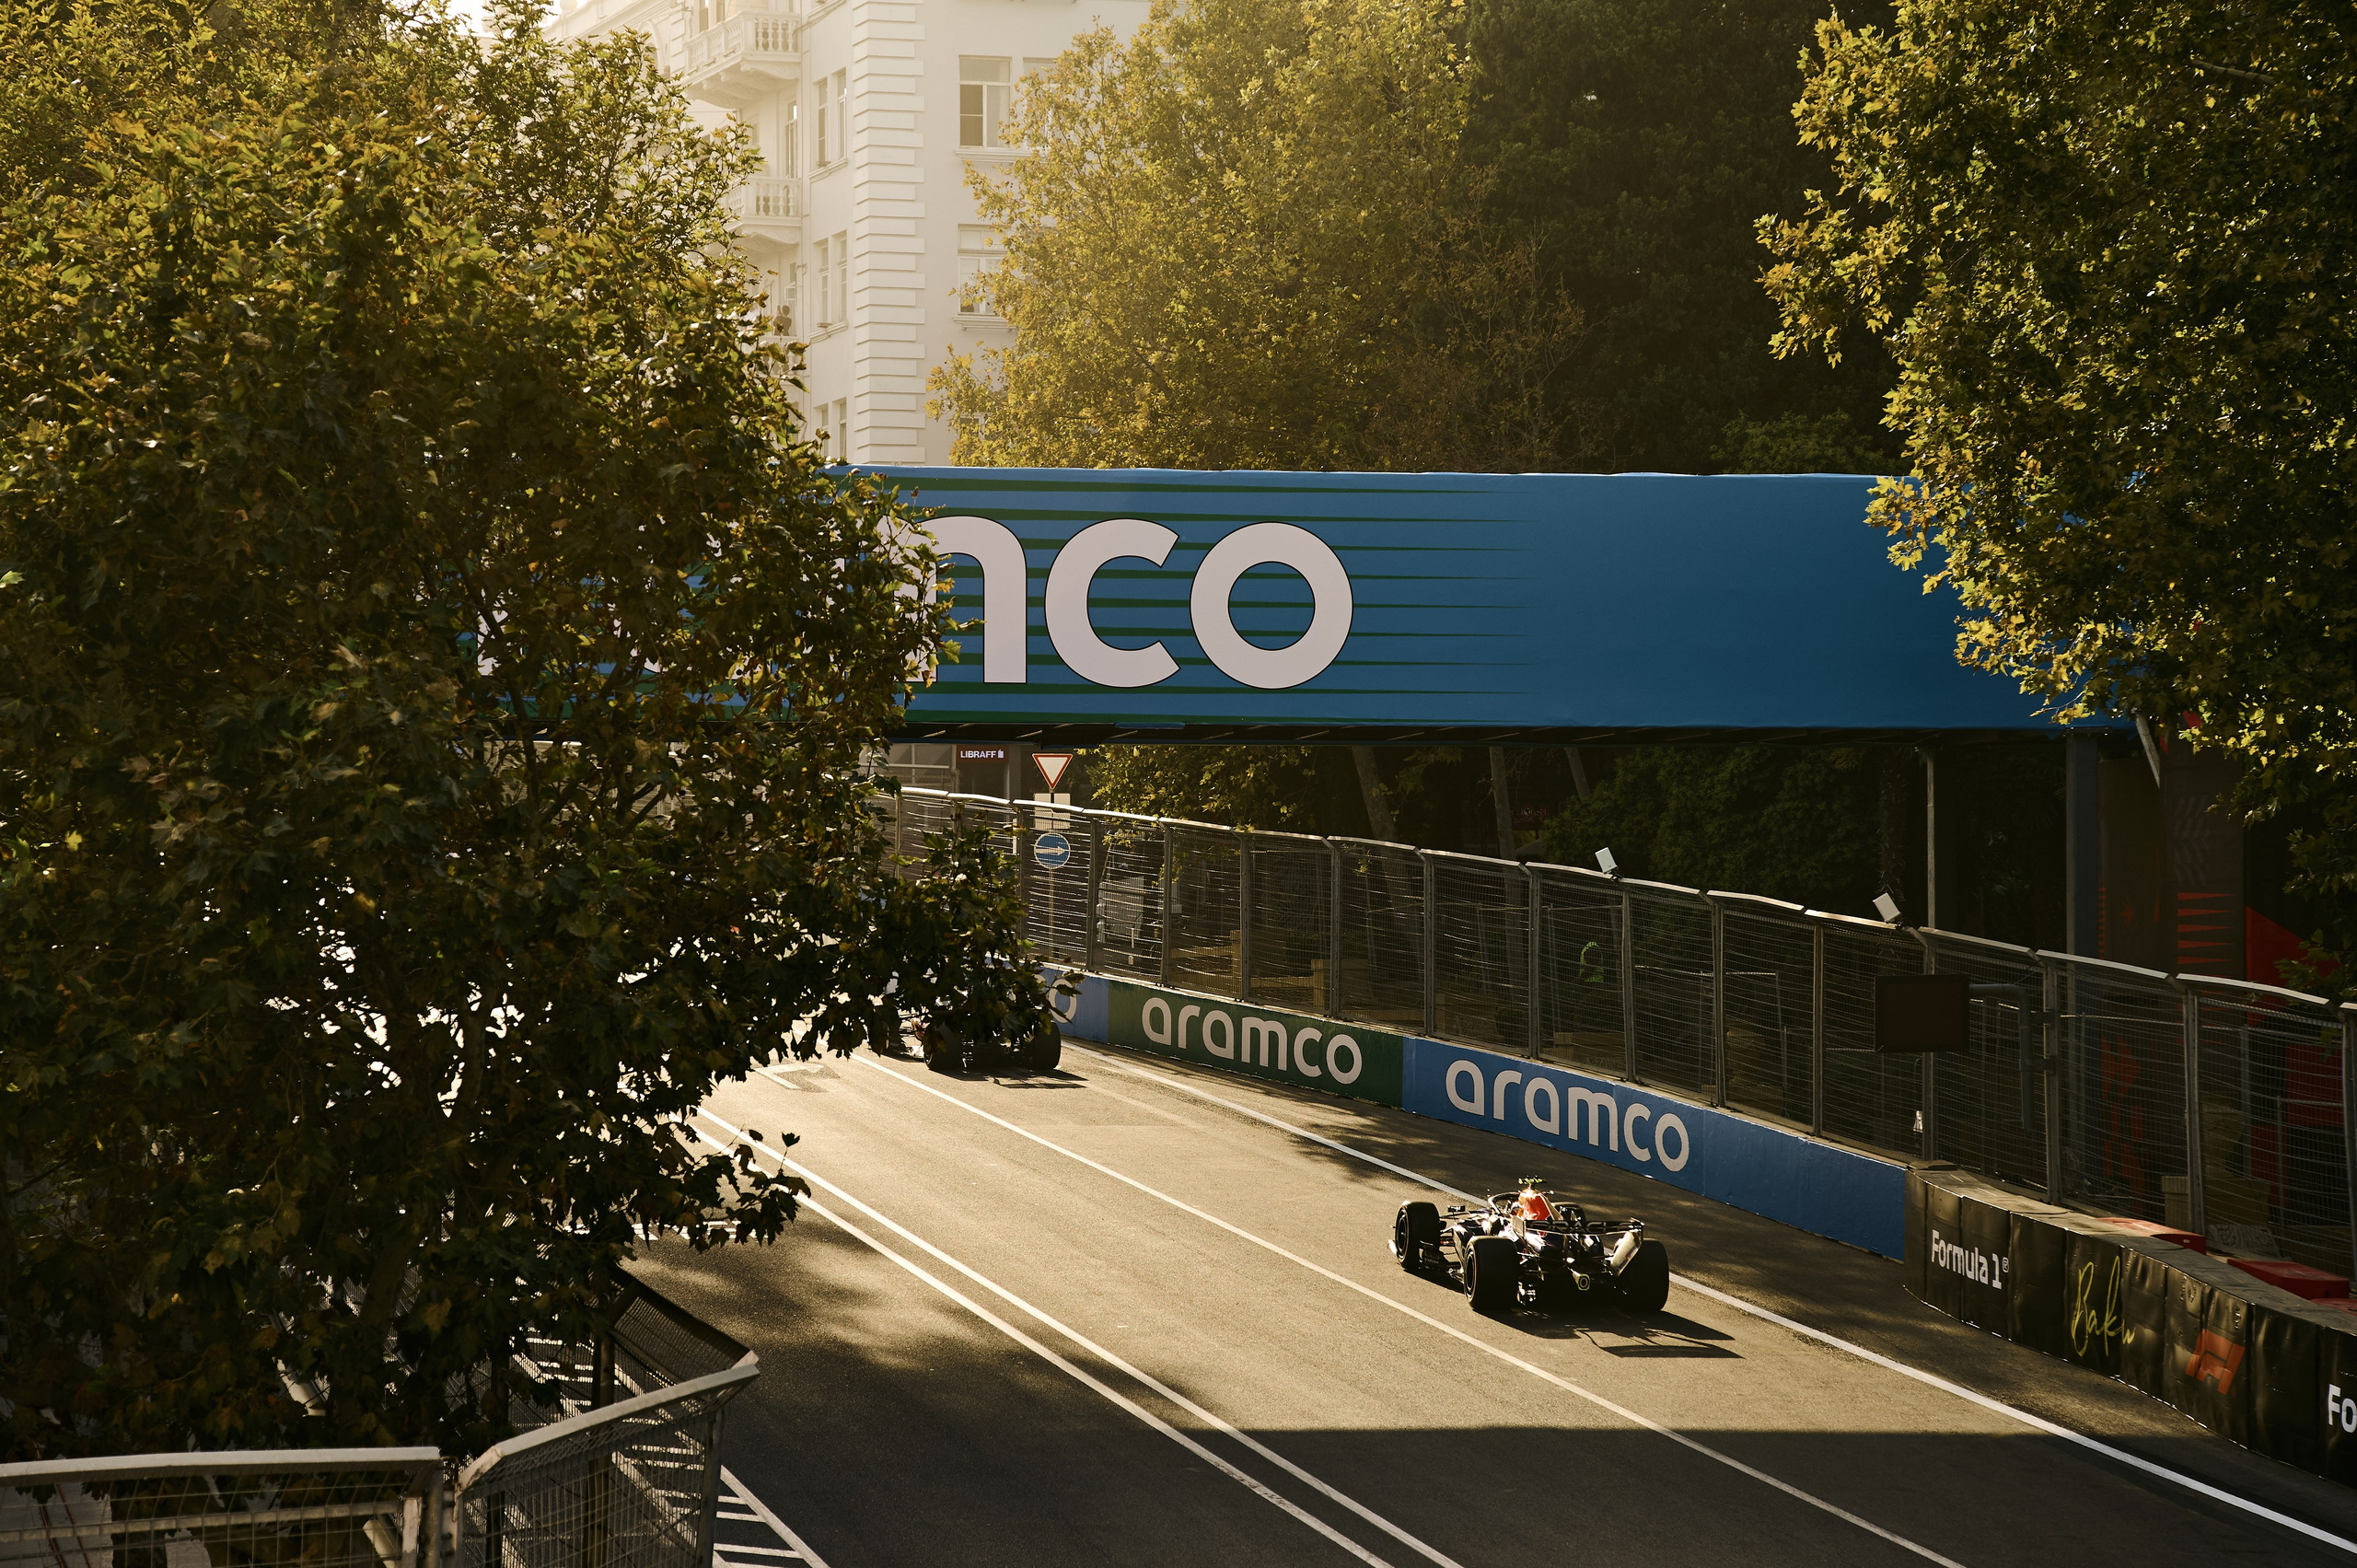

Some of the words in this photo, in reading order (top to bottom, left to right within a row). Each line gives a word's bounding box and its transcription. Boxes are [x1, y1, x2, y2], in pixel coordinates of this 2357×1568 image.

[960, 750, 997, 759] LIBRAFF
[1142, 997, 1363, 1085] aramco
[1445, 1060, 1689, 1172] aramco
[1931, 1228, 1989, 1285] Formula
[2071, 1255, 2136, 1357] Baku
